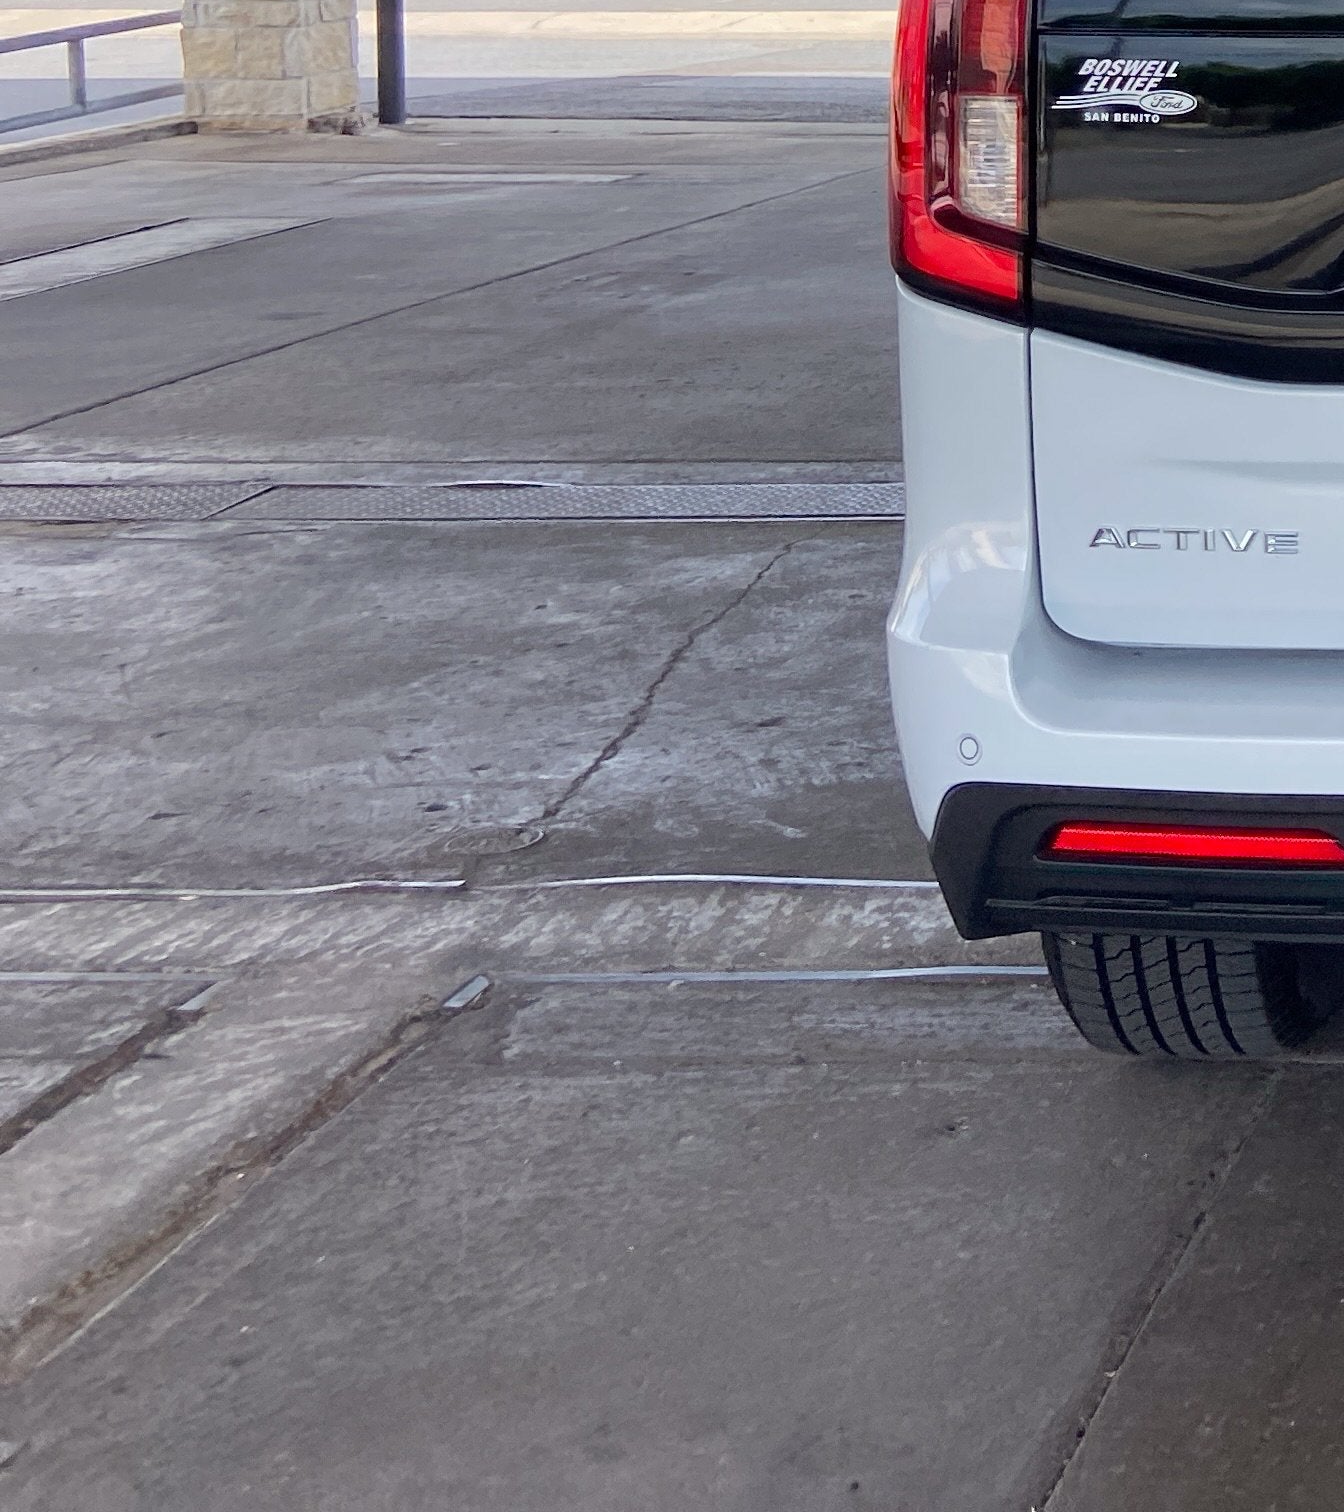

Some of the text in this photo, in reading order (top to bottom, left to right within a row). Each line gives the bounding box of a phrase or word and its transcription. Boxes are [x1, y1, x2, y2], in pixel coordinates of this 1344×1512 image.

[1078, 59, 1180, 78] BOSWELL
[1082, 76, 1163, 93] ELLIFF
[1150, 95, 1184, 109] Ford
[1083, 111, 1161, 124] SAN BENITO
[1089, 526, 1299, 555] ACTIVE
